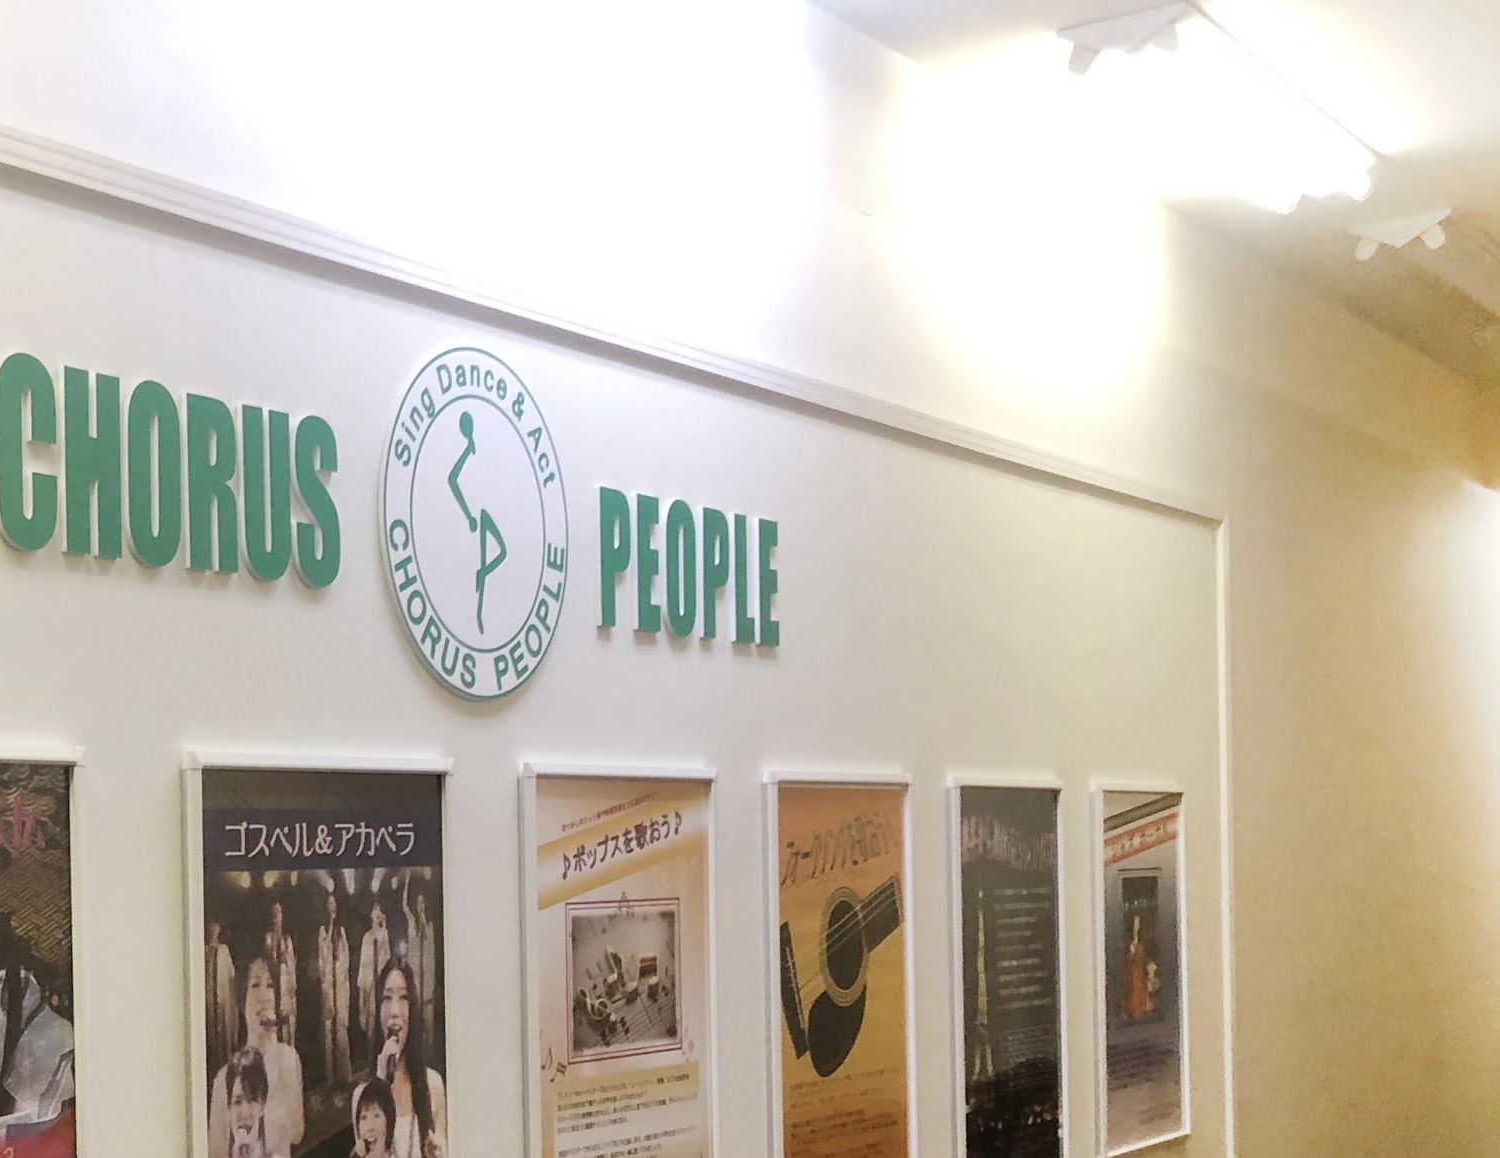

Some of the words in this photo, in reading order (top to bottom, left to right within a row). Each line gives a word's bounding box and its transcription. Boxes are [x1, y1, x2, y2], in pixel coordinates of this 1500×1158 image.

[393, 380, 438, 468] Sing
[436, 362, 509, 402] Dance
[511, 388, 528, 420] &
[527, 423, 560, 490] Act
[388, 517, 479, 690] CHORUS
[493, 541, 567, 692] PEOPLE
[598, 485, 781, 647] PEOPLE
[225, 821, 415, 857] ゴスペル&アカペラ
